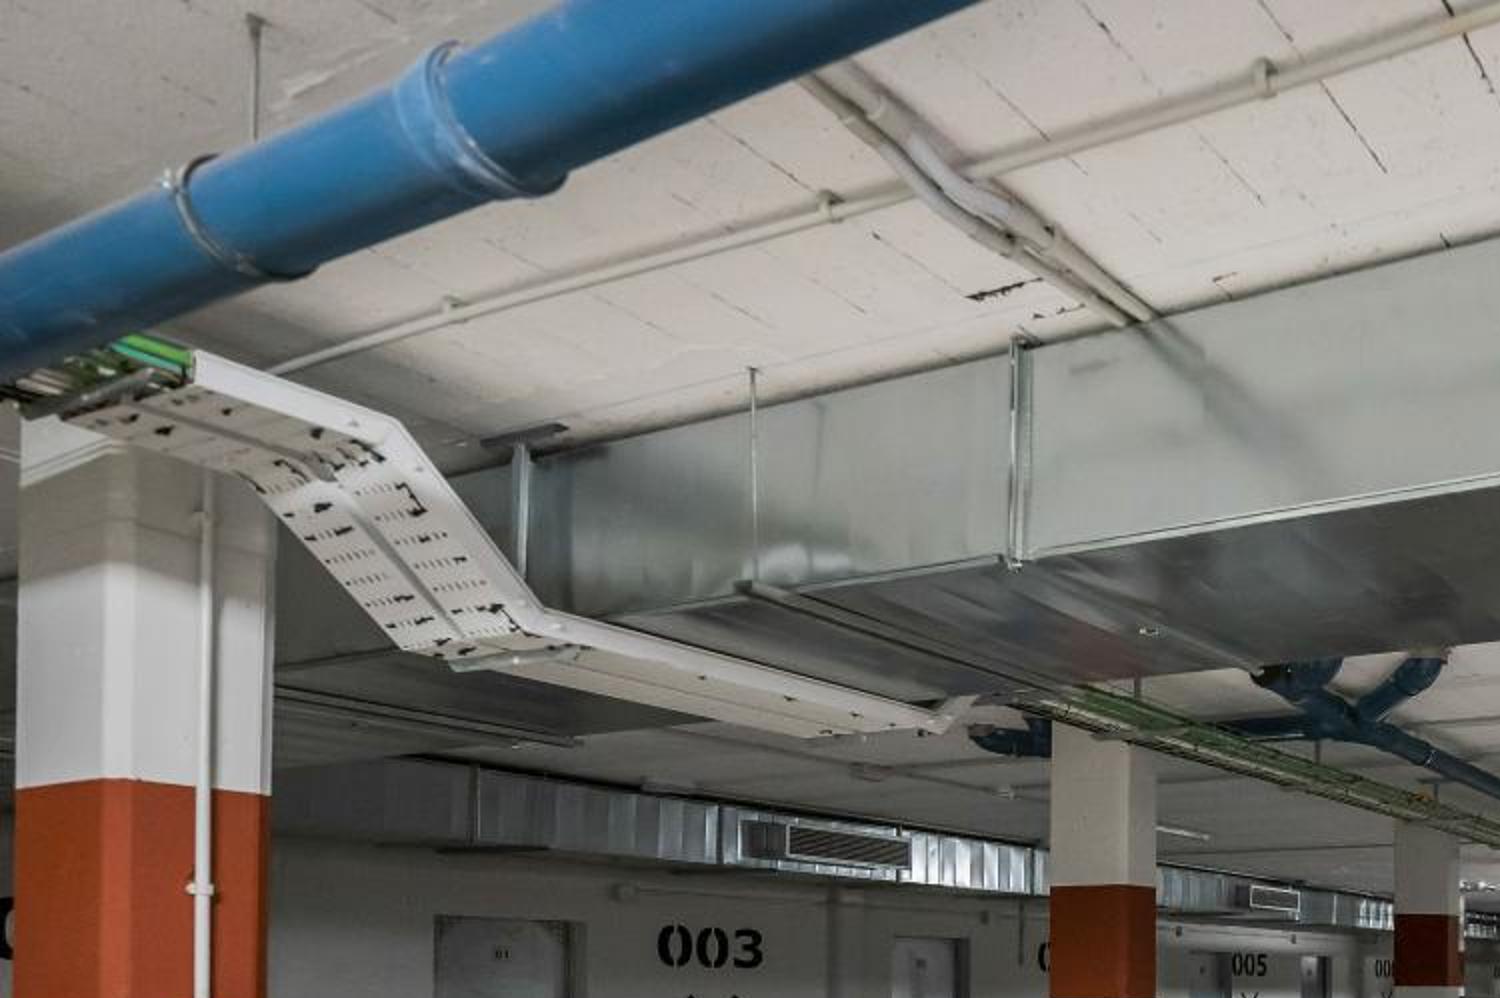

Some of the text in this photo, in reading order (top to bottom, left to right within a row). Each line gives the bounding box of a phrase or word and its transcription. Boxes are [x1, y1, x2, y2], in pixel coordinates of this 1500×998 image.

[657, 924, 763, 968] 003
[1232, 952, 1267, 977] 005
[1375, 959, 1393, 977] 00
